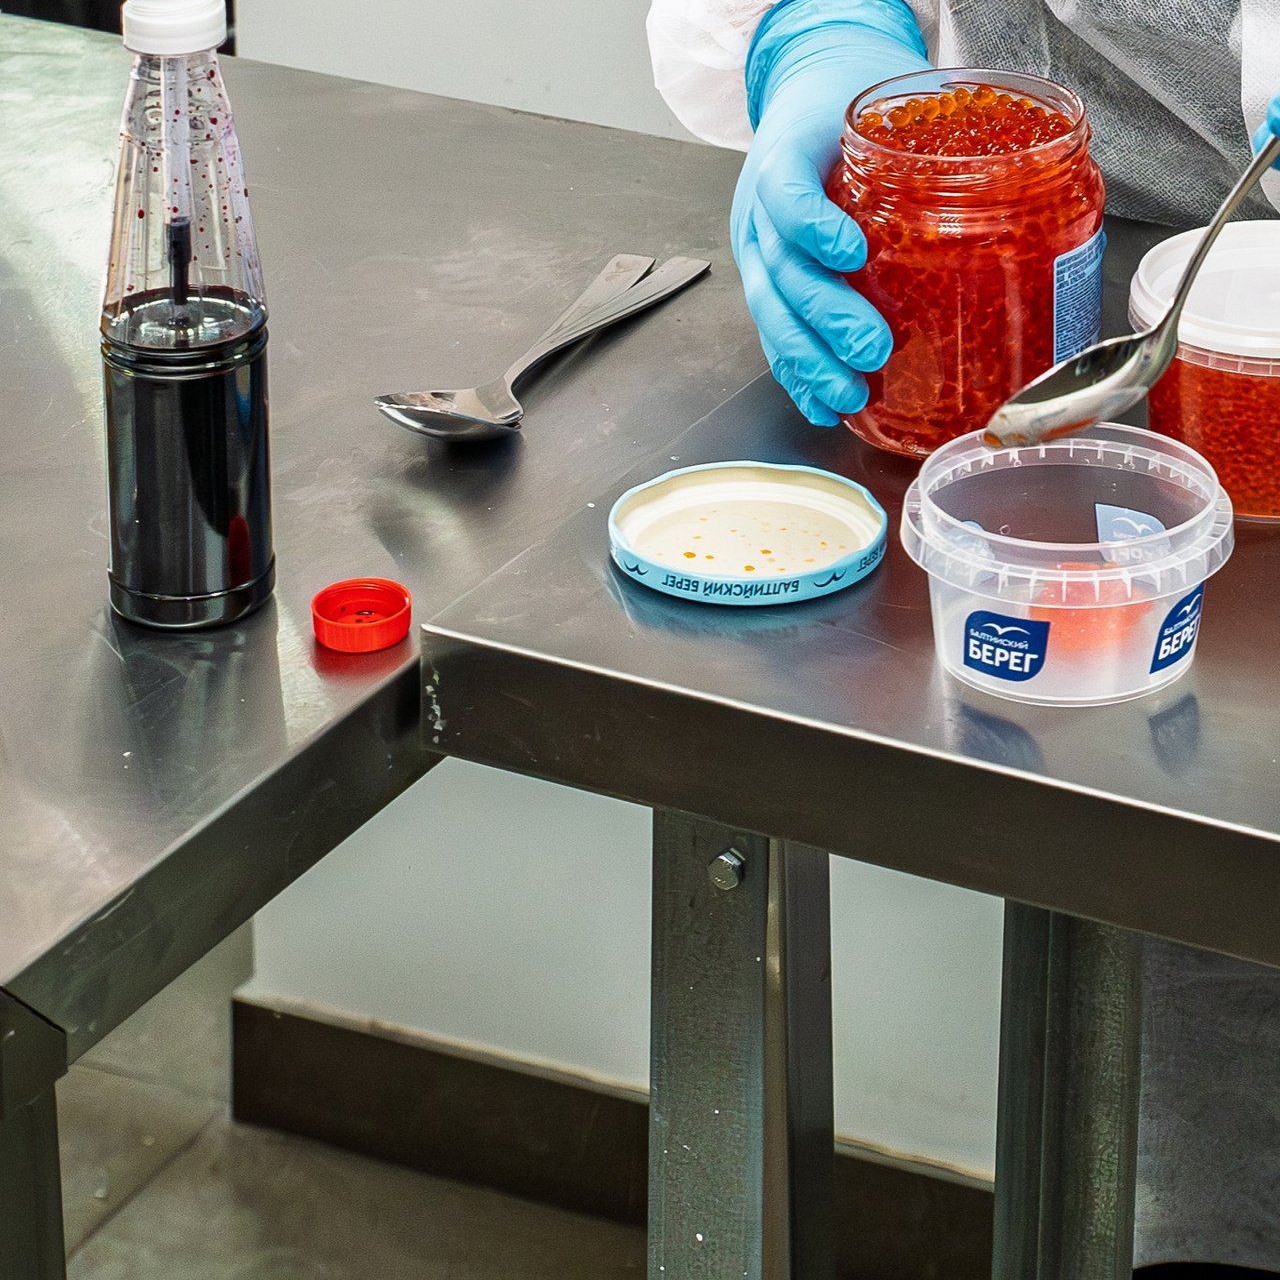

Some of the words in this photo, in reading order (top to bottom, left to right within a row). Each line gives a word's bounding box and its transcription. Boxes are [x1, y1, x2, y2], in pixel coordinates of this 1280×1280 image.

[661, 574, 699, 592] БЕРЕГ
[703, 580, 800, 599] БАЛТИЙСКИЙ
[968, 638, 1039, 673] БЕРЕГ
